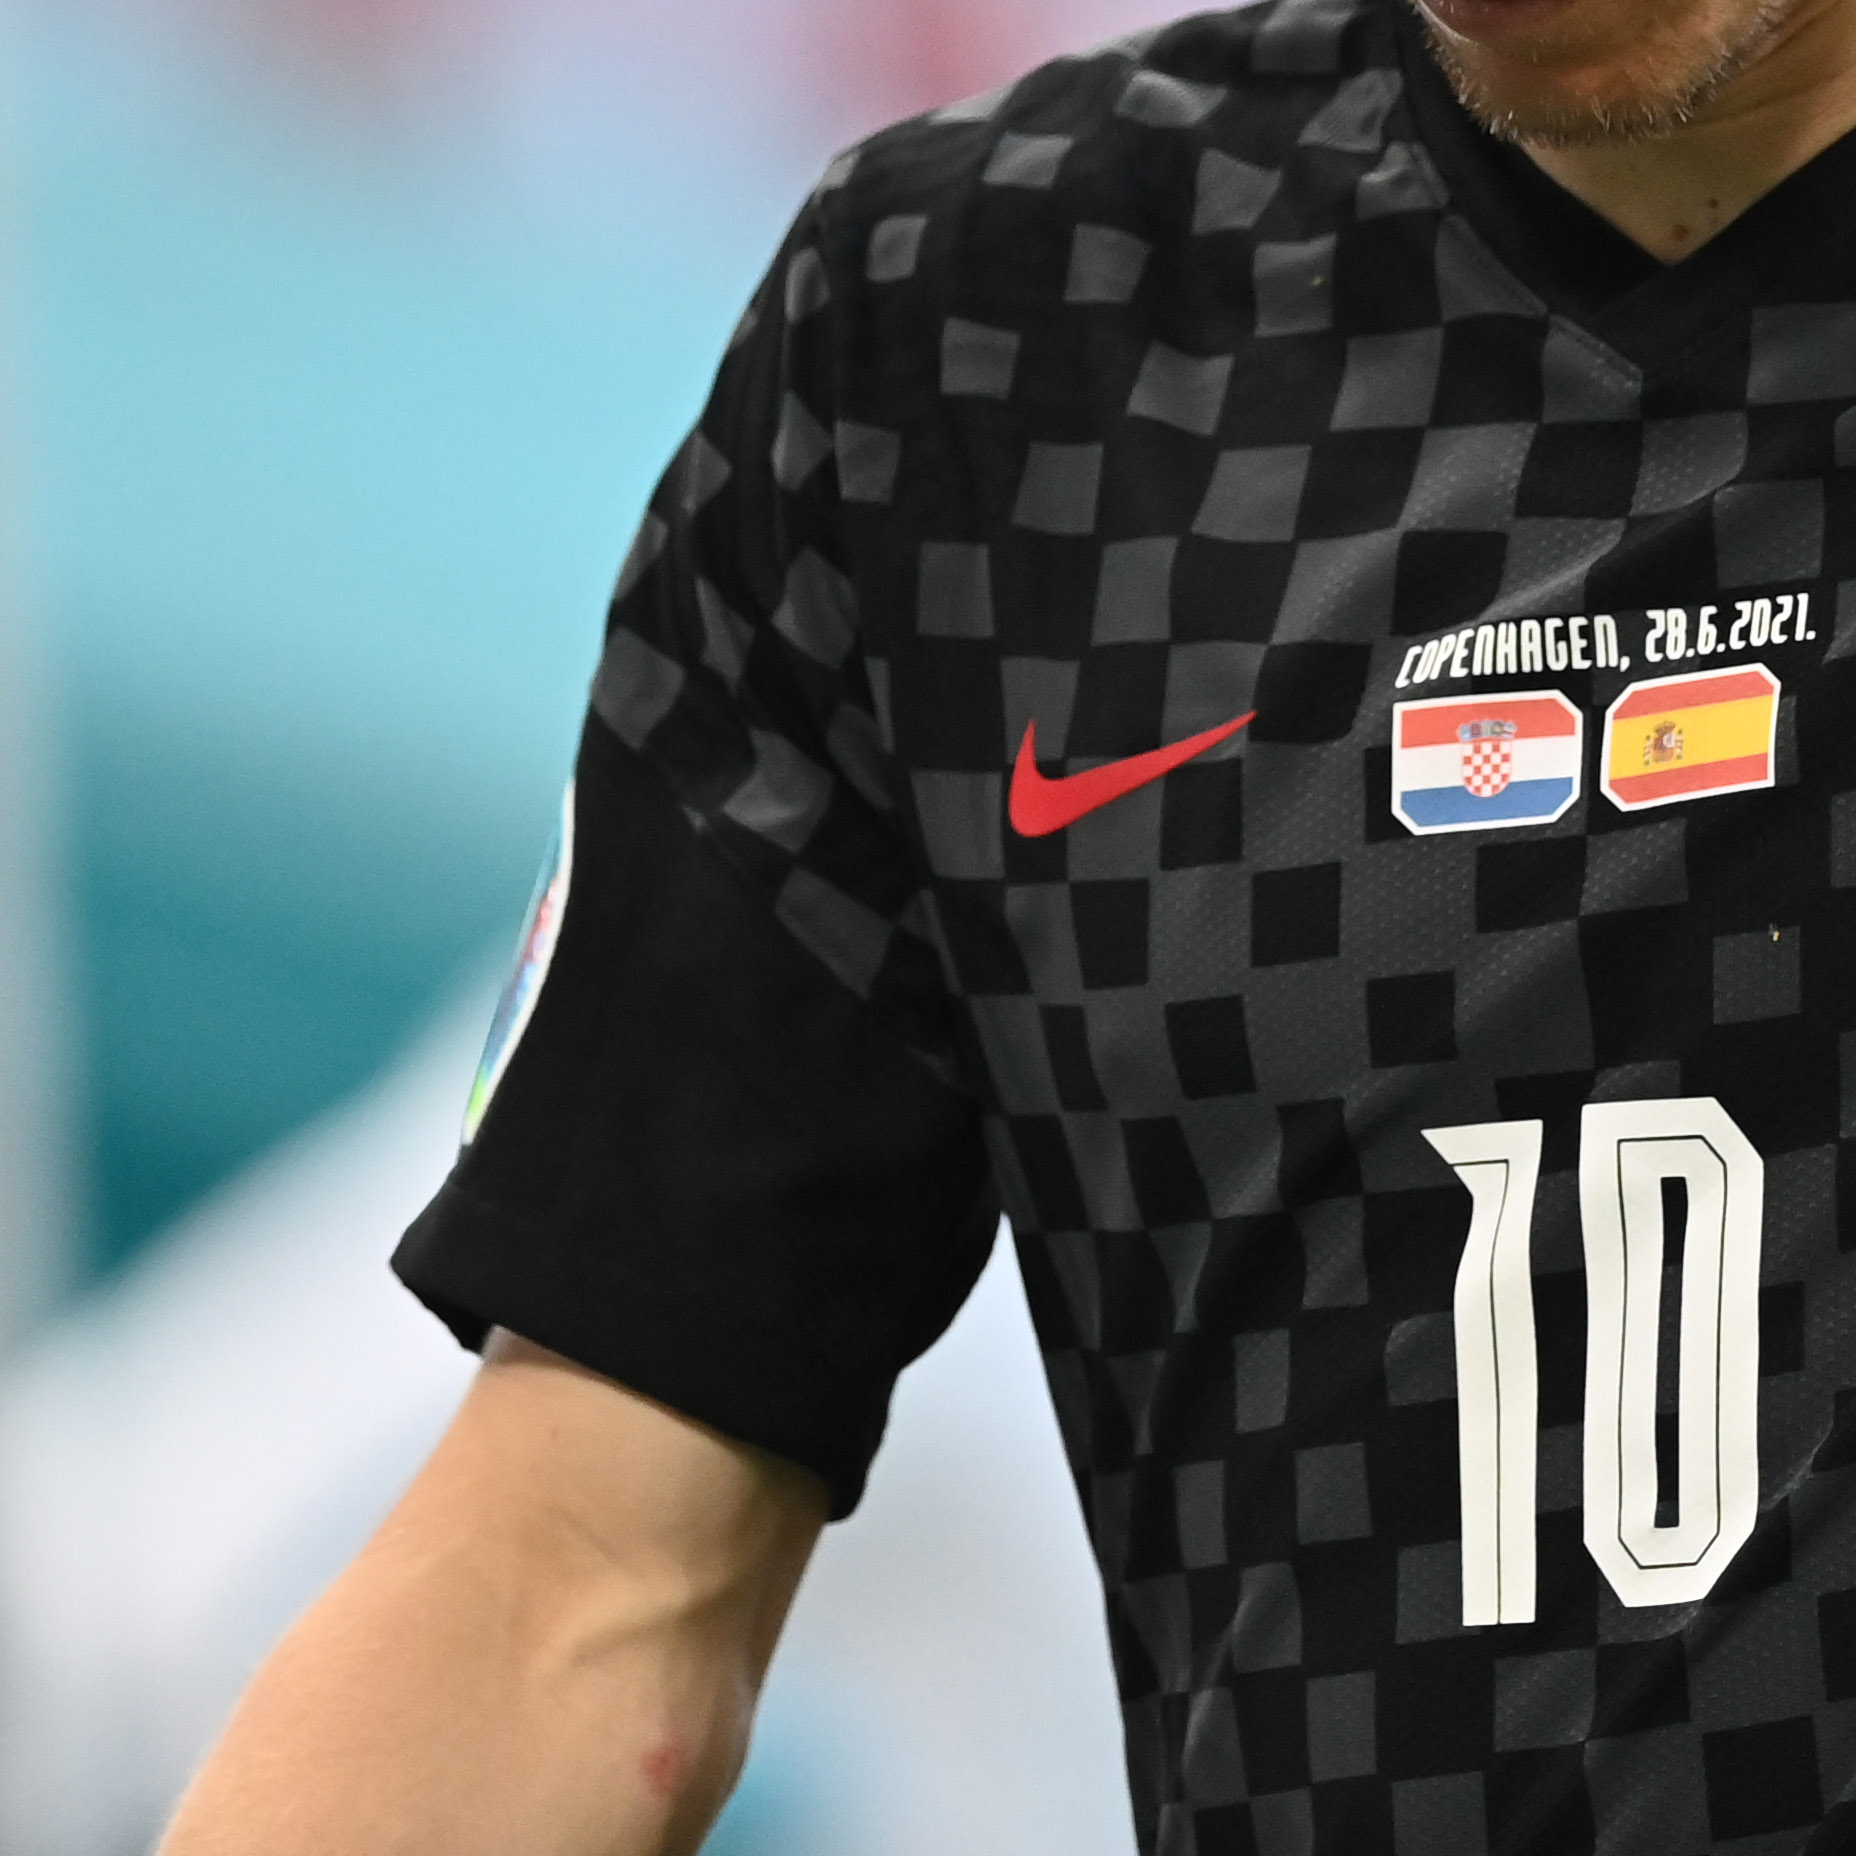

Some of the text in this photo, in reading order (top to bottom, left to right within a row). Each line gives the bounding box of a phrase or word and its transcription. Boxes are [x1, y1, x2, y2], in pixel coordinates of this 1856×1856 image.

[1394, 592, 1817, 688] COPENHAGEN, 28.6.2021.
[1420, 1096, 1765, 1626] 10
